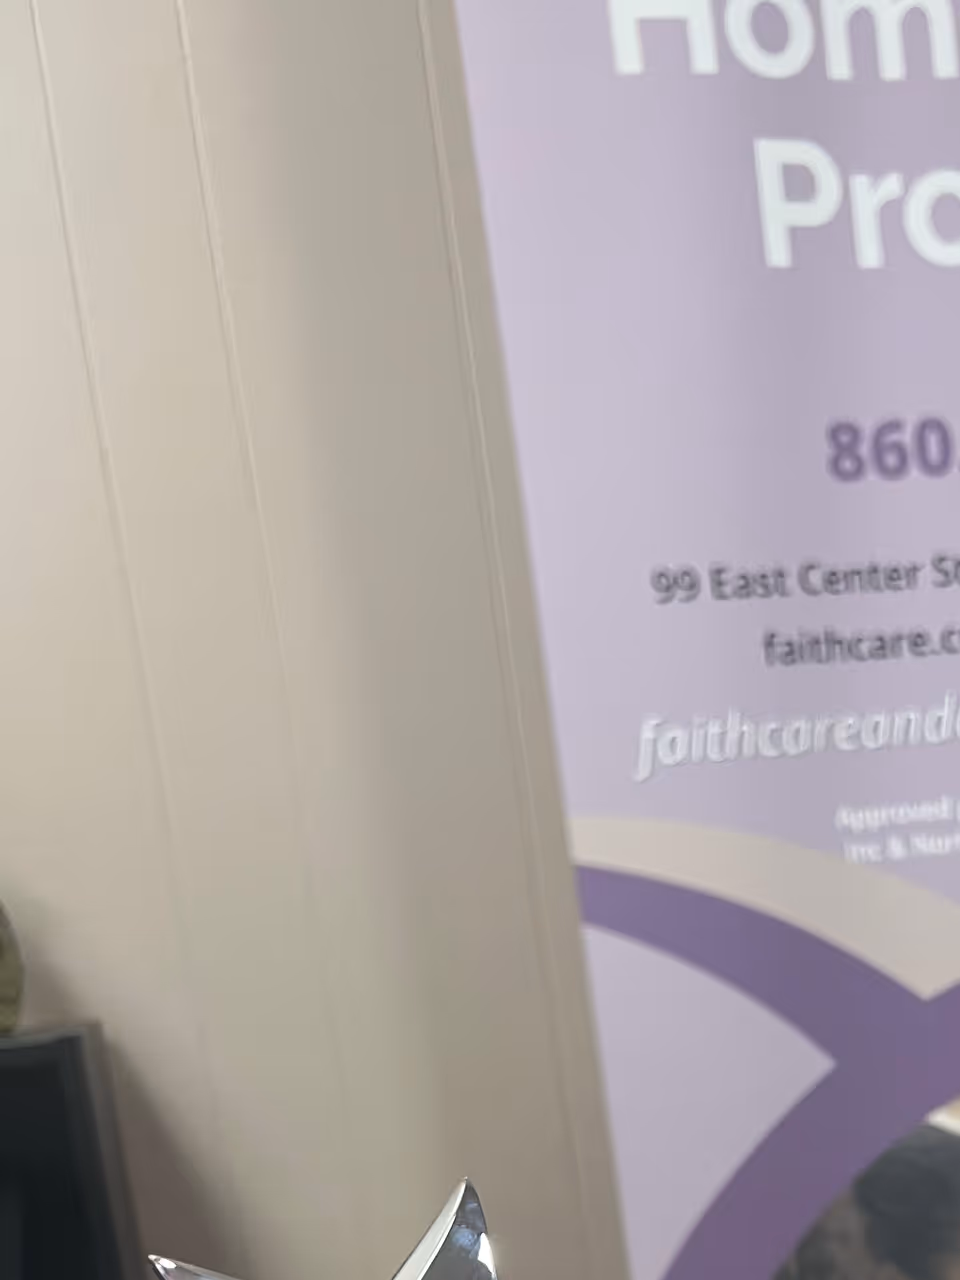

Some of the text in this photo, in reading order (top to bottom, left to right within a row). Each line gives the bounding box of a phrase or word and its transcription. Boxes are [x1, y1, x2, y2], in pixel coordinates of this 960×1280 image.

[651, 566, 700, 602] 99
[709, 562, 790, 600] East
[798, 558, 922, 597] Center
[834, 796, 953, 833] Approved
